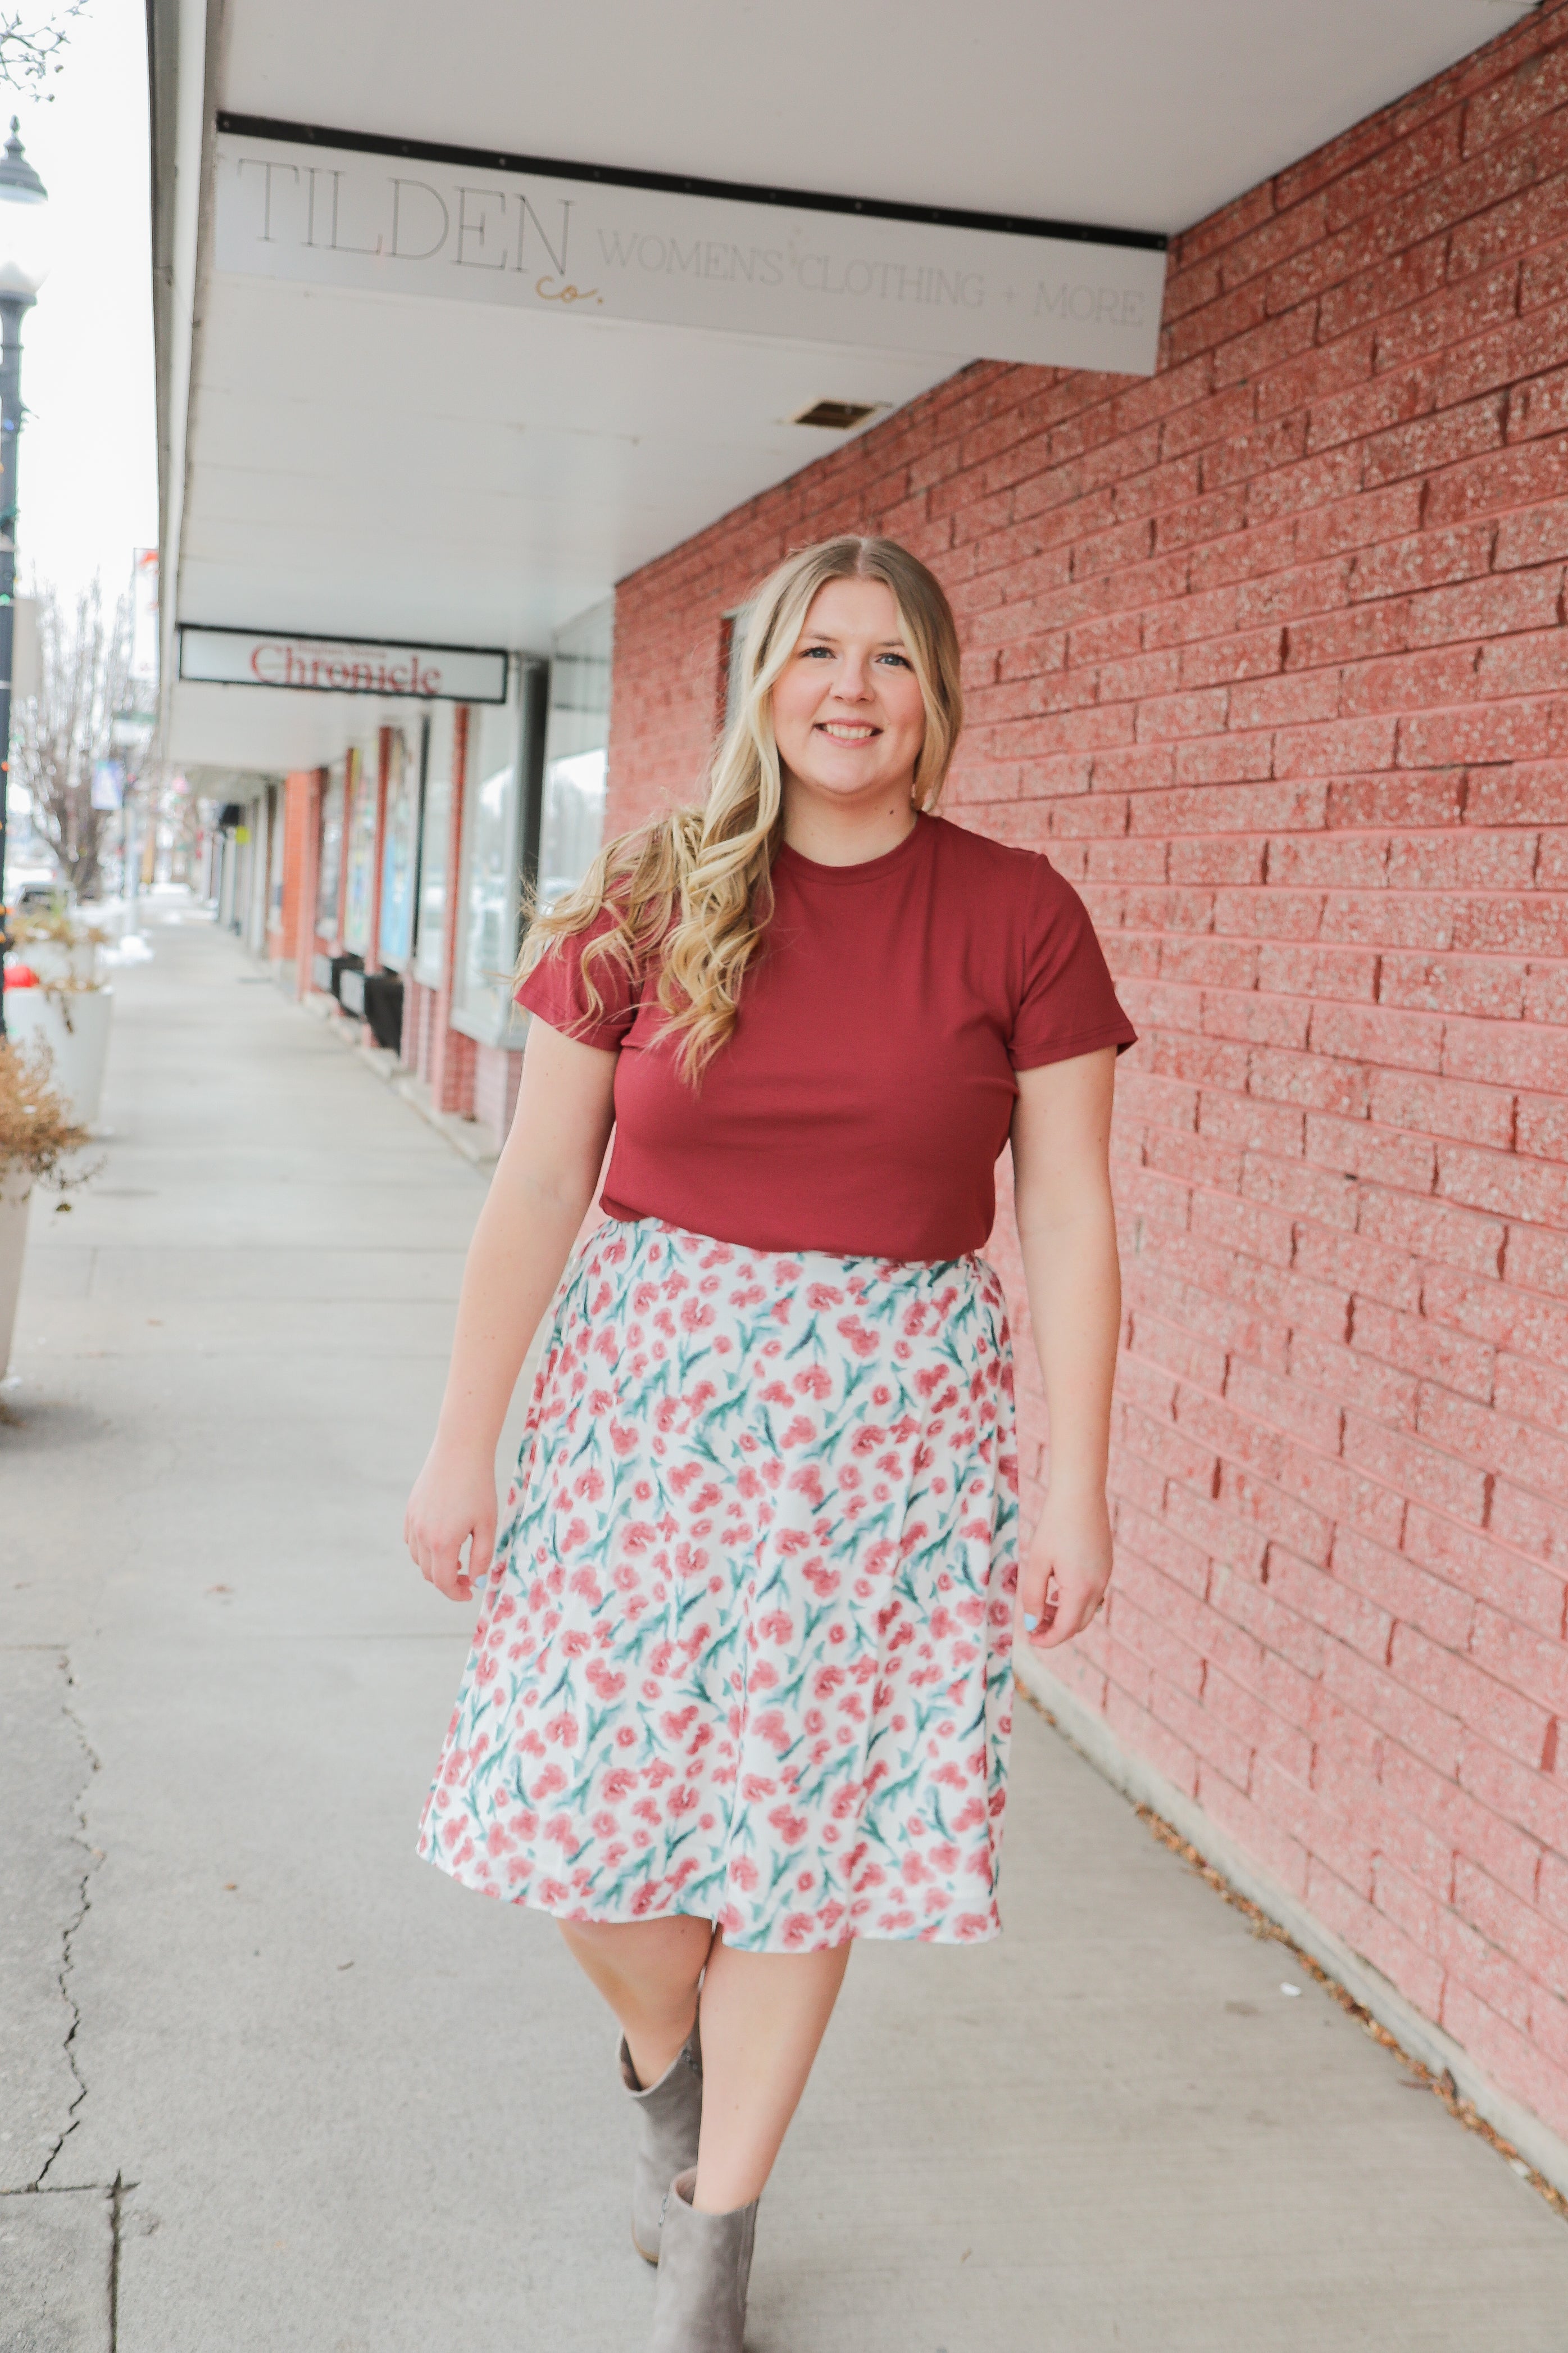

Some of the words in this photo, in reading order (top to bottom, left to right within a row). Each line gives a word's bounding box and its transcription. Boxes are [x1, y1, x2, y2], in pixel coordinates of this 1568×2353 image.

[237, 158, 576, 276] TILDEN
[797, 253, 985, 309] CLOTHING
[1032, 280, 1145, 327] MORE
[251, 642, 441, 695] Chronicle
